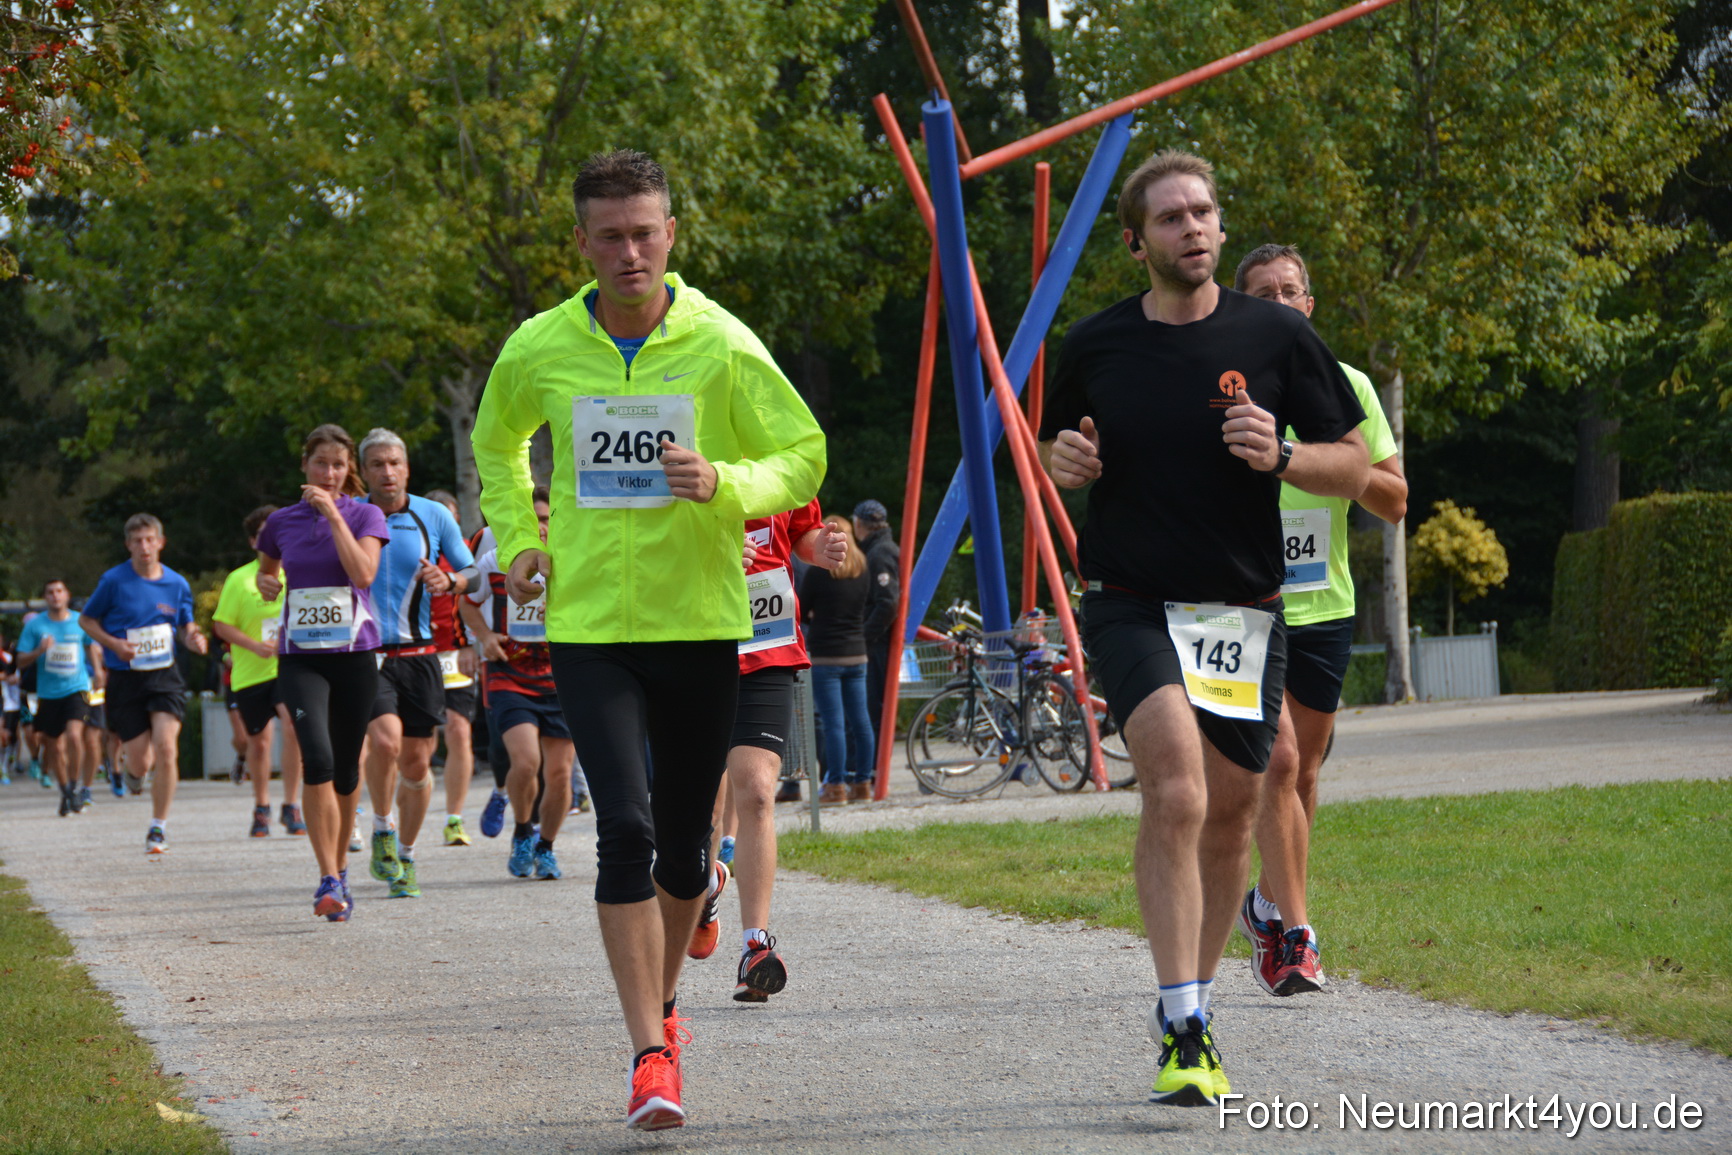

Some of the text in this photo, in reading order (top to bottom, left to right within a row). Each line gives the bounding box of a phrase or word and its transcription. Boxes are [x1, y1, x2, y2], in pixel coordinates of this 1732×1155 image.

[618, 406, 659, 416] BOCK
[590, 430, 676, 464] 2468
[617, 476, 653, 488] Viktor
[1281, 517, 1305, 526] OCK
[747, 578, 770, 591] OCK
[297, 606, 342, 625] 2336
[1207, 615, 1241, 627] BOCK
[137, 638, 165, 654] 2044
[1192, 637, 1242, 674] 143
[1200, 682, 1233, 698] Thomas
